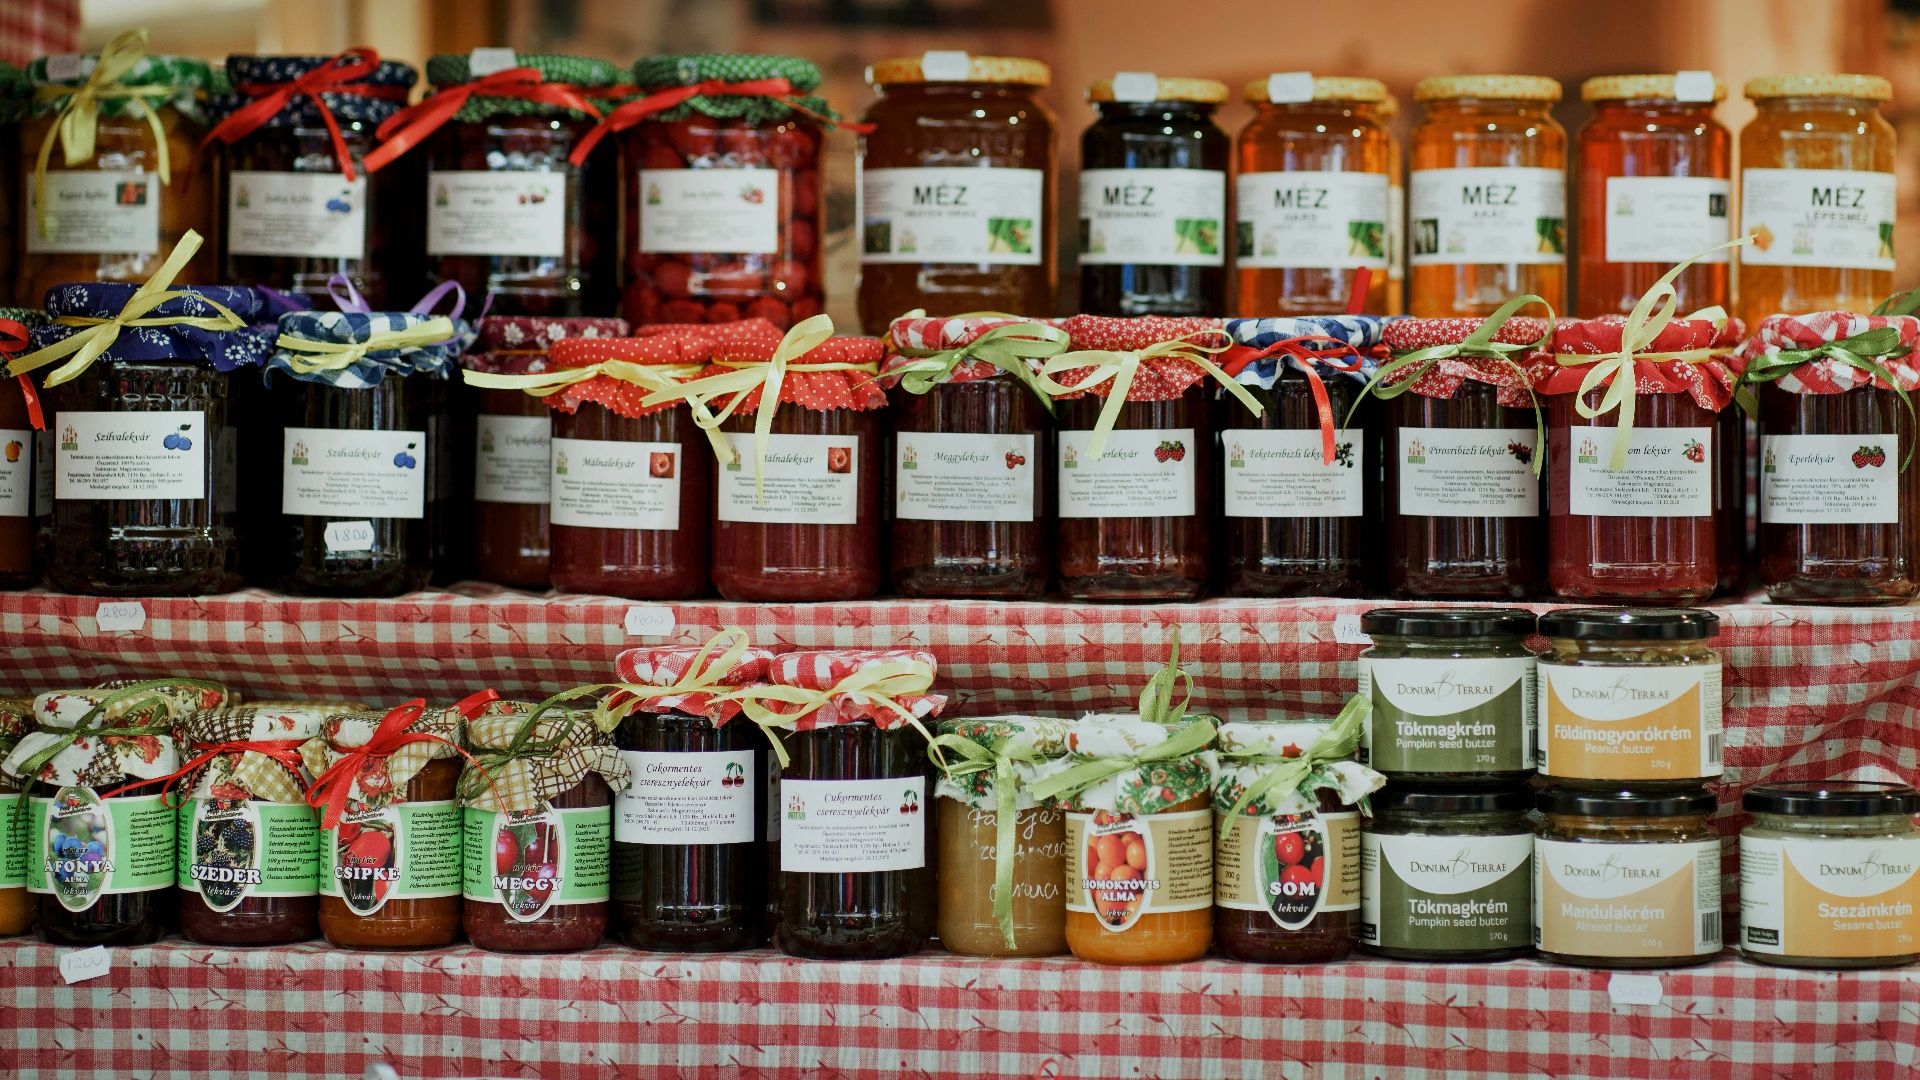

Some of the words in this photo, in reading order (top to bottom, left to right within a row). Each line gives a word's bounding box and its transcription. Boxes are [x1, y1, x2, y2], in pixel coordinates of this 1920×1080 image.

[912, 180, 968, 206] MÉZ
[1102, 180, 1154, 206] MÉZ
[1274, 181, 1328, 208] MÉZ
[1462, 180, 1518, 205] MÉZ
[1811, 181, 1865, 209] MÉZ
[94, 431, 151, 443] Szilvalekvár
[326, 447, 382, 461] Szilvalekvár
[1479, 444, 1506, 458] lekvár
[1643, 444, 1672, 457] lekvár
[582, 457, 636, 470] Málnalekvár
[764, 453, 814, 465] álnalekvár
[934, 451, 990, 464] Meggylekvár
[1788, 453, 1836, 466] Eperlekvár
[334, 527, 368, 543] 1800
[1454, 683, 1494, 695] TERRAE
[1630, 688, 1670, 700] TERRAE
[1395, 721, 1496, 740] Tökmagkrém
[1554, 724, 1691, 746] Földimogyorókrém
[1396, 738, 1437, 751] Pumpkin
[1439, 739, 1463, 749] seed
[1465, 738, 1496, 749] butter
[1585, 743, 1619, 754] Peanut
[1621, 743, 1656, 754] butter
[1476, 755, 1490, 763] 170
[1651, 760, 1665, 768] 170
[646, 762, 703, 774] Cukormentes
[640, 776, 712, 789] cseresznyelekvár
[824, 792, 882, 804] Cukormentes
[816, 806, 891, 819] cseresznyelekvár
[44, 856, 116, 873] ÁFONYA
[1470, 861, 1507, 873] TERRAE
[190, 864, 262, 884] SZEDER
[334, 866, 400, 881] CSIPKE
[1620, 866, 1661, 879] TERRAE
[494, 875, 563, 891] MEGGY
[1082, 878, 1161, 890] HOMOKTÖVIS
[1269, 881, 1316, 896] SOM
[63, 887, 90, 896] lekvár
[1101, 892, 1137, 902] ALMA
[512, 900, 541, 909] lekvár
[1278, 903, 1309, 913] lekvár
[1408, 898, 1508, 918] Tökmagkrém
[1818, 902, 1913, 919] Szezámkrém
[1562, 903, 1665, 920] Mandulakrém
[1409, 915, 1450, 929] Pumpkin
[1453, 916, 1477, 927] seed
[1479, 916, 1508, 927] butter
[1576, 921, 1612, 933] Almond
[1615, 922, 1648, 933] butter
[1833, 920, 1873, 931] Sesame
[1876, 919, 1903, 930] butter
[1489, 932, 1502, 940] 170
